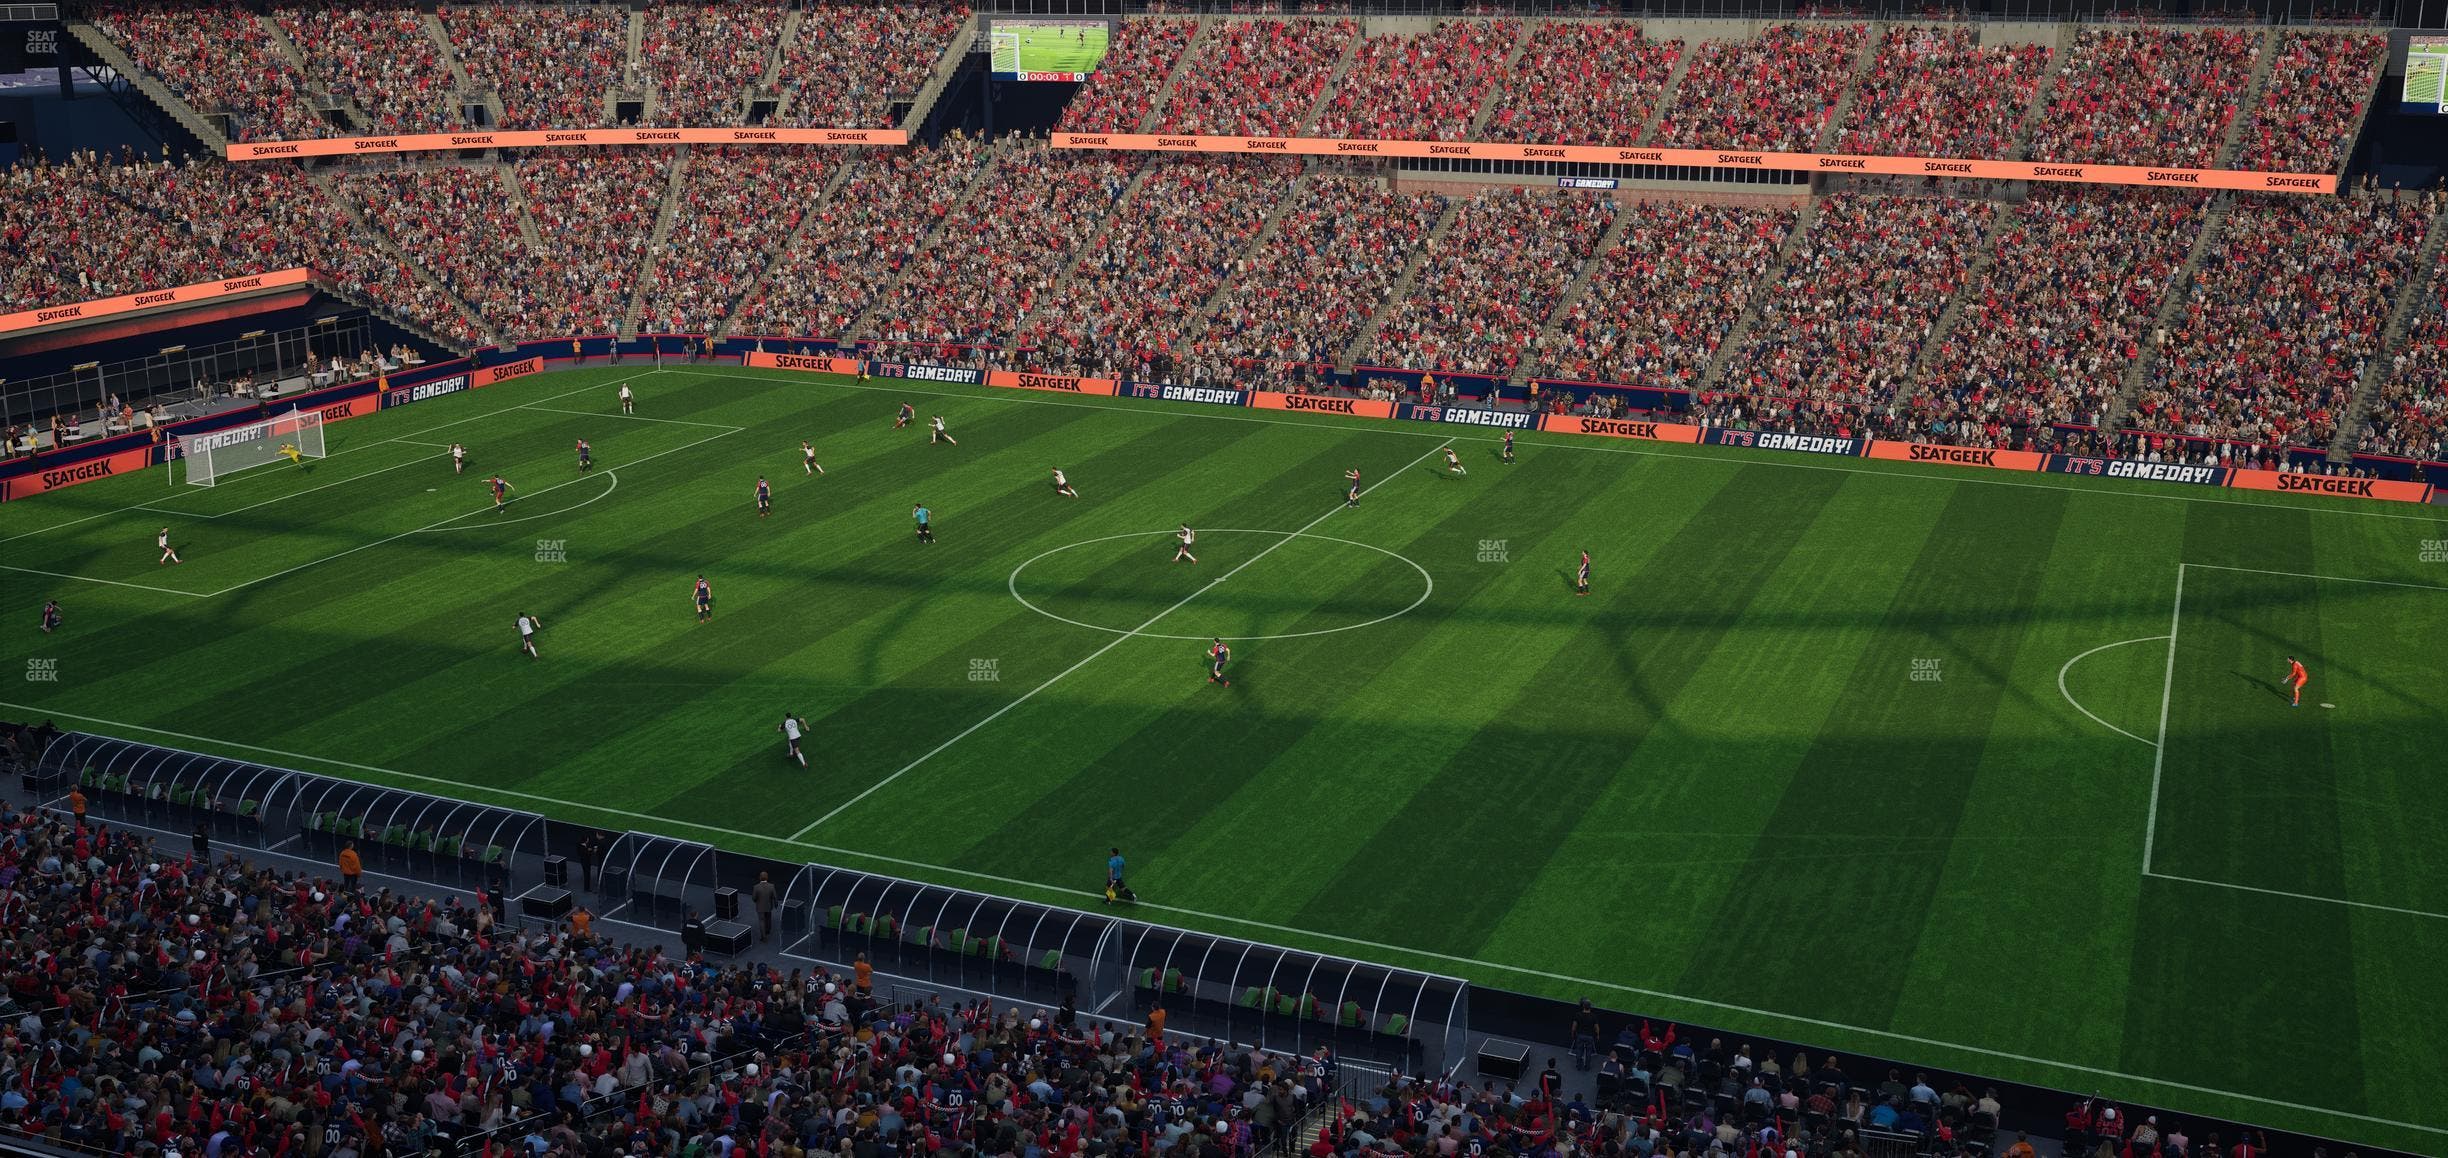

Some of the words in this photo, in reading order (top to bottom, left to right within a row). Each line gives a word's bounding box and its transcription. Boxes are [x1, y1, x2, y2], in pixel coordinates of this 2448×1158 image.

[451, 135, 494, 145] SEATGEEK
[545, 133, 587, 142] SEATGEEK
[636, 131, 681, 140] SEATGEEK
[734, 131, 776, 140] SEATGEEK
[827, 132, 868, 141] SEATGEEK
[1069, 136, 1108, 146] SEATGEEK
[354, 139, 398, 150] SEATGEEK
[1157, 138, 1197, 148] SEATGEEK
[1247, 140, 1287, 150] SEATGEEK
[1337, 142, 1378, 152] SEATGEEK
[252, 144, 299, 156] SEATGEEK
[1429, 145, 1471, 155] SEATGEEK
[1523, 147, 1566, 158] SEATGEEK
[1619, 151, 1663, 161] SEATGEEK
[1718, 154, 1762, 165] SEATGEEK
[1819, 158, 1865, 169] SEATGEEK
[1924, 162, 1972, 173] SEATGEEK
[2033, 166, 2083, 178] SEATGEEK
[2147, 171, 2199, 183] SEATGEEK
[2266, 176, 2321, 189] SEATGEEK
[223, 277, 262, 292] SEATGEEK
[134, 290, 176, 307] SEATGEEK
[37, 306, 82, 323] SEATGEEK
[775, 354, 833, 372] SEATGEEK
[493, 360, 536, 381] SEATGEEK
[880, 363, 905, 378] IT'S
[907, 365, 976, 383] GAMEDAY!
[1018, 373, 1081, 392] SEATGEEK
[390, 388, 411, 407] IT'S
[412, 376, 465, 401] GAMEDAY!
[1132, 383, 1159, 398] IT'S
[1163, 386, 1240, 405] GAMEDAY!
[1285, 395, 1355, 414] SEATGEEK
[1411, 405, 1441, 421] IT'S
[1445, 408, 1530, 428] GAMEDAY!
[1580, 418, 1658, 439] SEATGEEK
[1720, 430, 1755, 446] IT'S
[1758, 433, 1853, 454] GAMEDAY!
[1909, 444, 1997, 467] SEATGEEK
[43, 458, 112, 489] SEATGEEK
[2065, 457, 2104, 475] IT'S
[2107, 460, 2215, 484] GAMEDAY!
[2277, 473, 2374, 498] SEATGEEK
[949, 1094, 963, 1106] 00
[325, 1129, 341, 1144] 00
